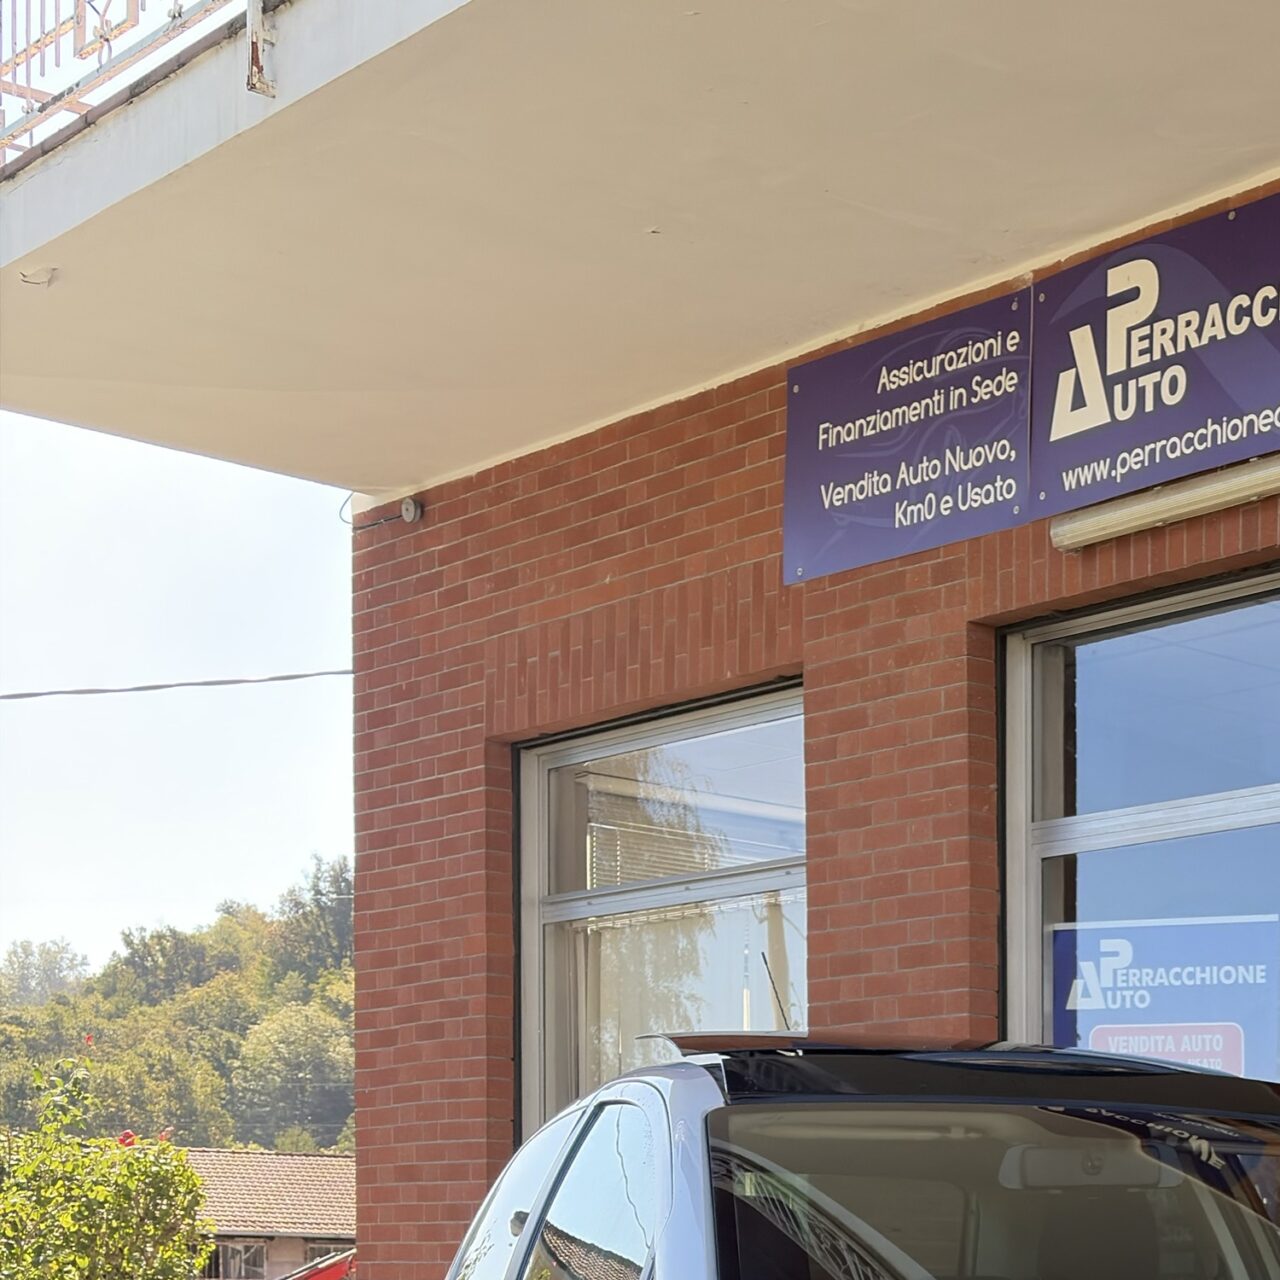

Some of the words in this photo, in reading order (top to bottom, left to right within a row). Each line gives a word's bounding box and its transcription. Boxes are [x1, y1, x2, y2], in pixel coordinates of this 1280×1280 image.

[877, 331, 1002, 394] Assicurazioni
[1006, 330, 1020, 352] e
[1049, 324, 1188, 442] AUTO
[818, 388, 945, 450] Finanziamenti
[949, 386, 967, 410] in
[971, 367, 1019, 404] Sede
[820, 470, 892, 509] Vendita
[896, 456, 942, 490] Auto
[945, 438, 1017, 475] Nuovo,
[895, 493, 936, 529] Km0
[940, 496, 954, 515] e
[958, 475, 1017, 511] Usato
[1065, 961, 1151, 1010] AUTO
[1099, 938, 1267, 988] PERRACCHIONE
[1107, 1035, 1177, 1054] VENDITA
[1180, 1034, 1224, 1052] AUTO
